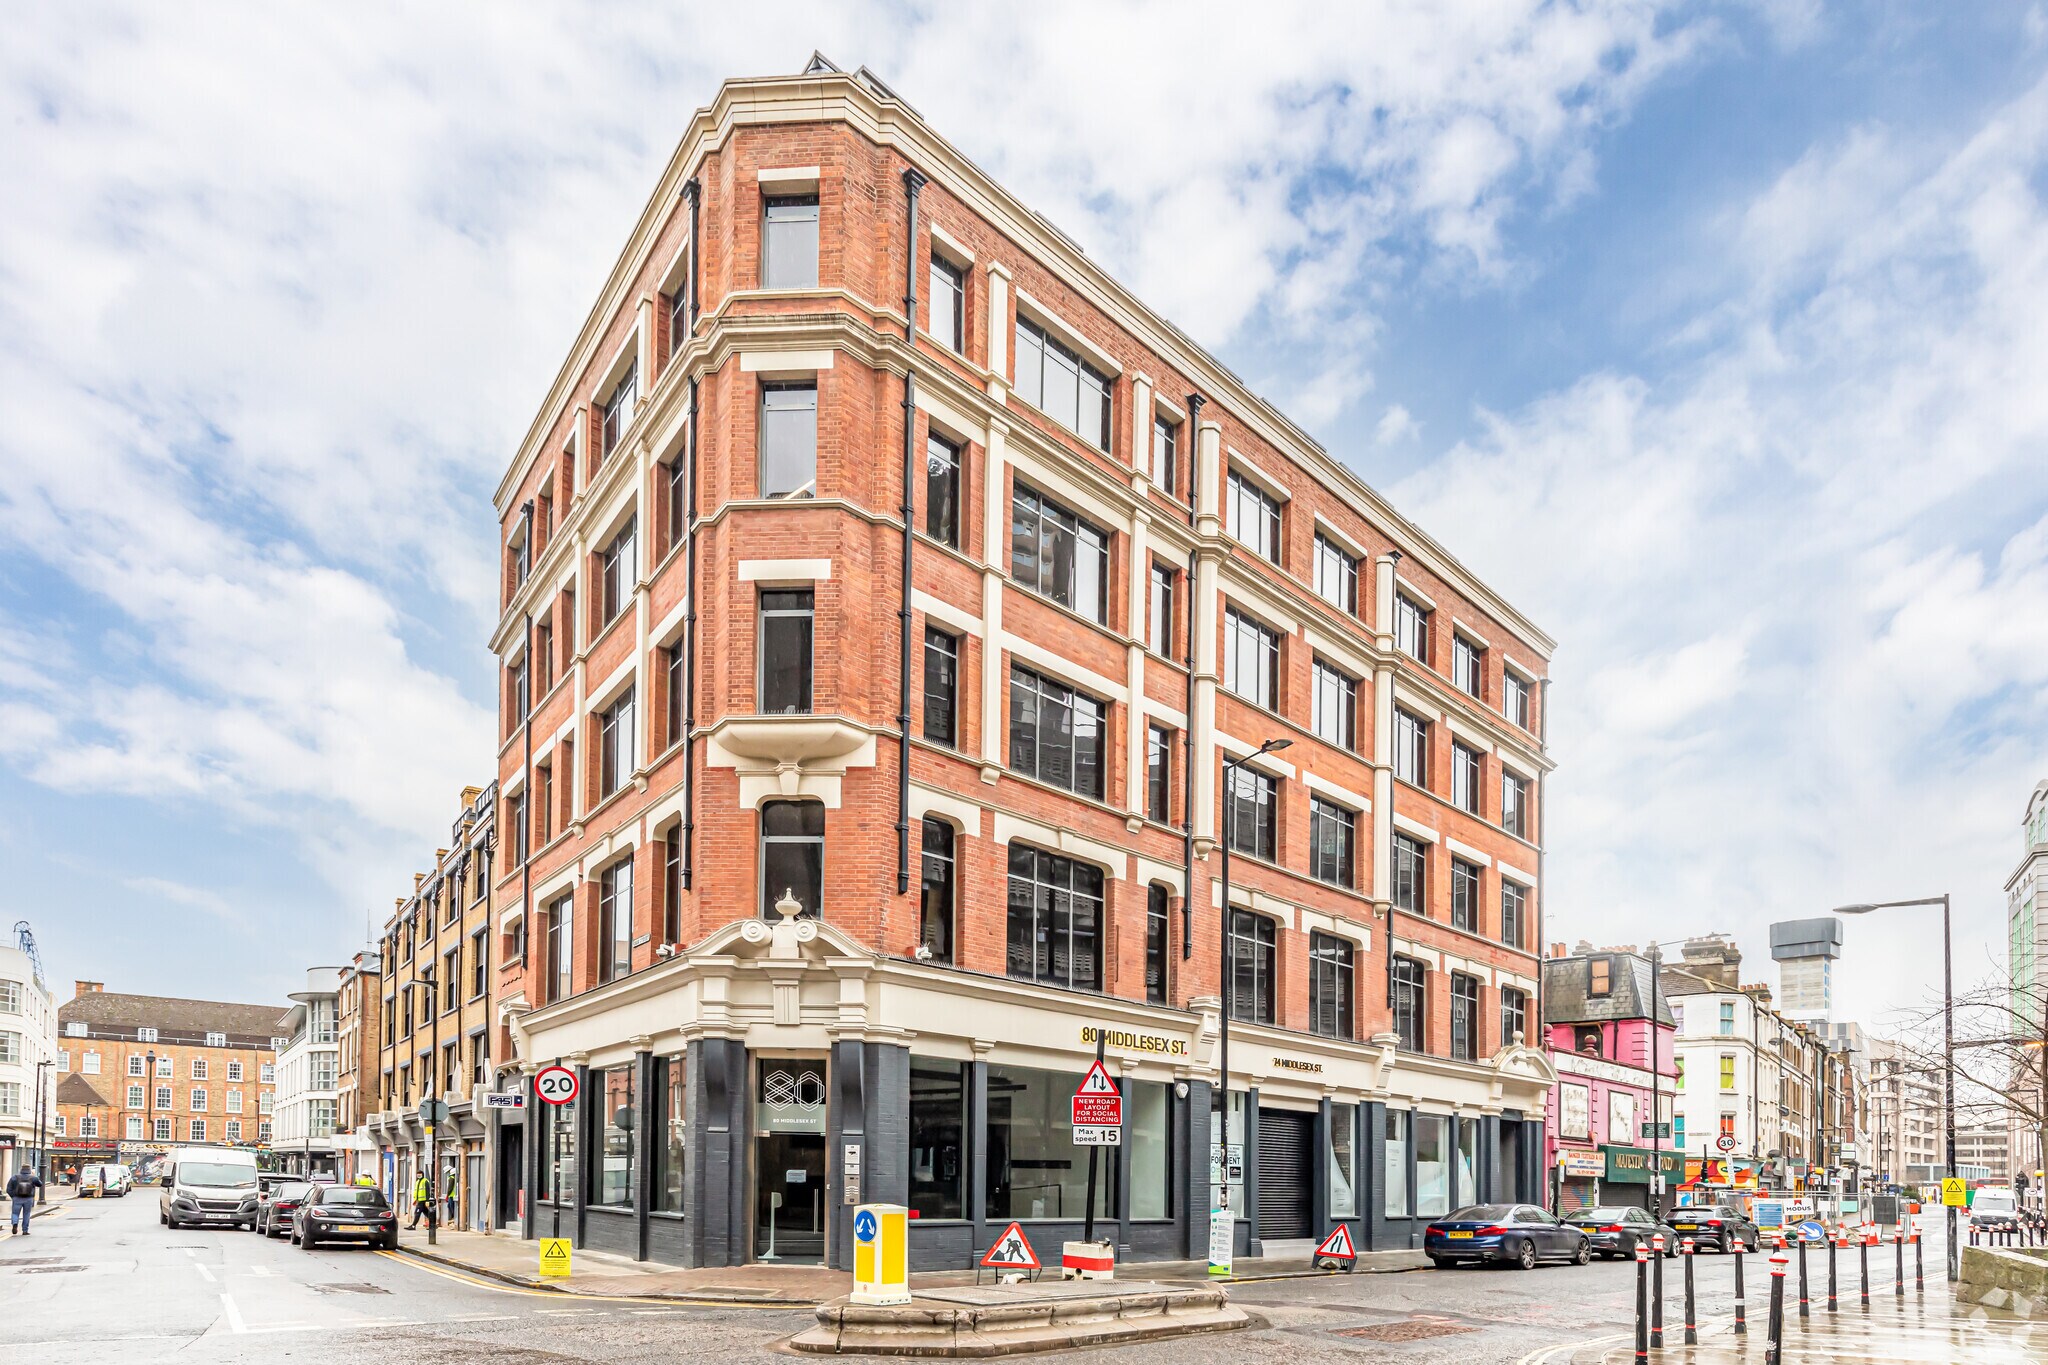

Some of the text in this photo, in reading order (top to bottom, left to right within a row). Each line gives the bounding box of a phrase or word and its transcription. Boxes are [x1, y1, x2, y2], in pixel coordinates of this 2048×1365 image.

[1082, 1026, 1188, 1055] 80 MIDDLESEX ST.
[1281, 1058, 1314, 1072] MIDDLESEX
[542, 1077, 573, 1094] 20
[1100, 1130, 1117, 1142] 15
[1720, 1139, 1734, 1147] 30
[1615, 1153, 1645, 1169] MAJESTIC
